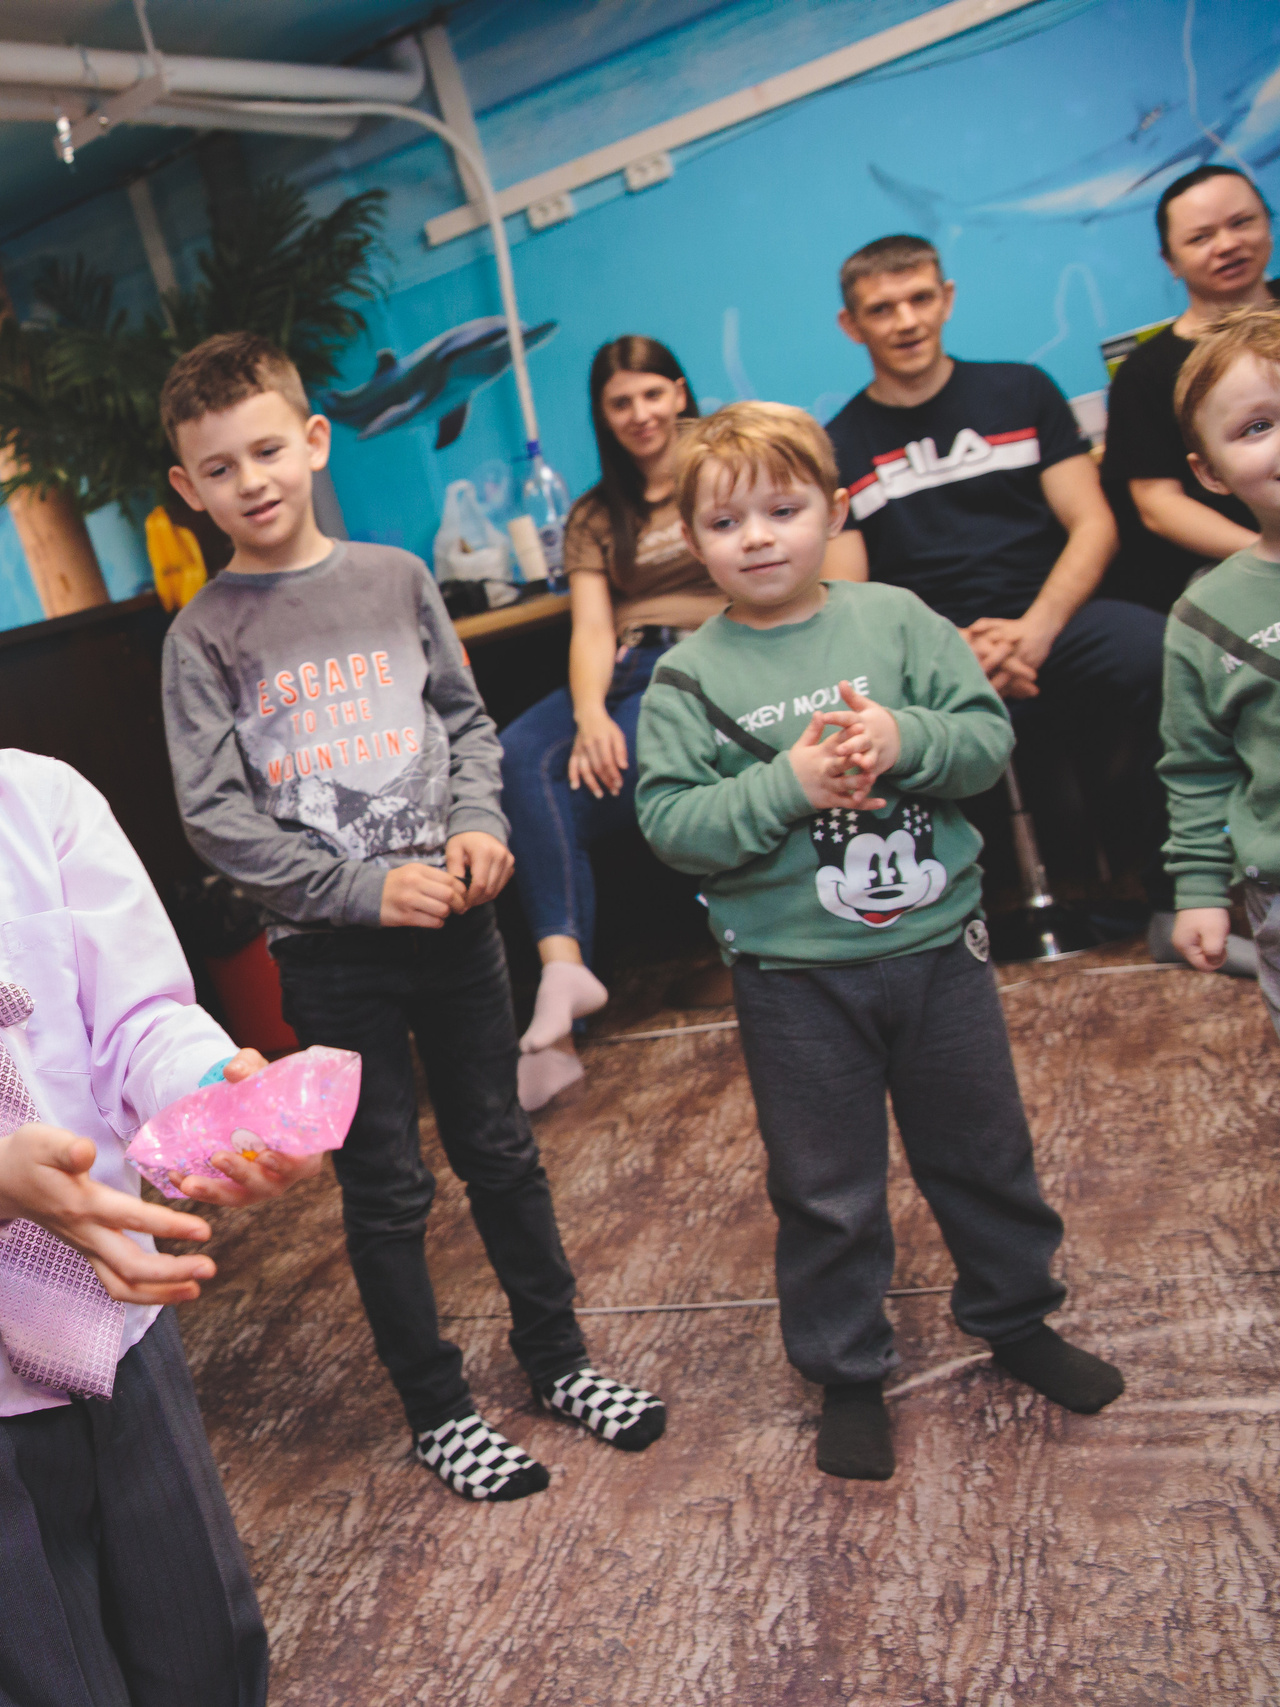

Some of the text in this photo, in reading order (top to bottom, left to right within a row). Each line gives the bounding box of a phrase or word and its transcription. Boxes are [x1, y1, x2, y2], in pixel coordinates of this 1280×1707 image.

[875, 427, 992, 486] FILA
[257, 651, 393, 717] ESCAPE
[793, 675, 870, 716] MOUE
[290, 699, 372, 735] TO THE
[268, 728, 419, 786] MOUNTAINS
